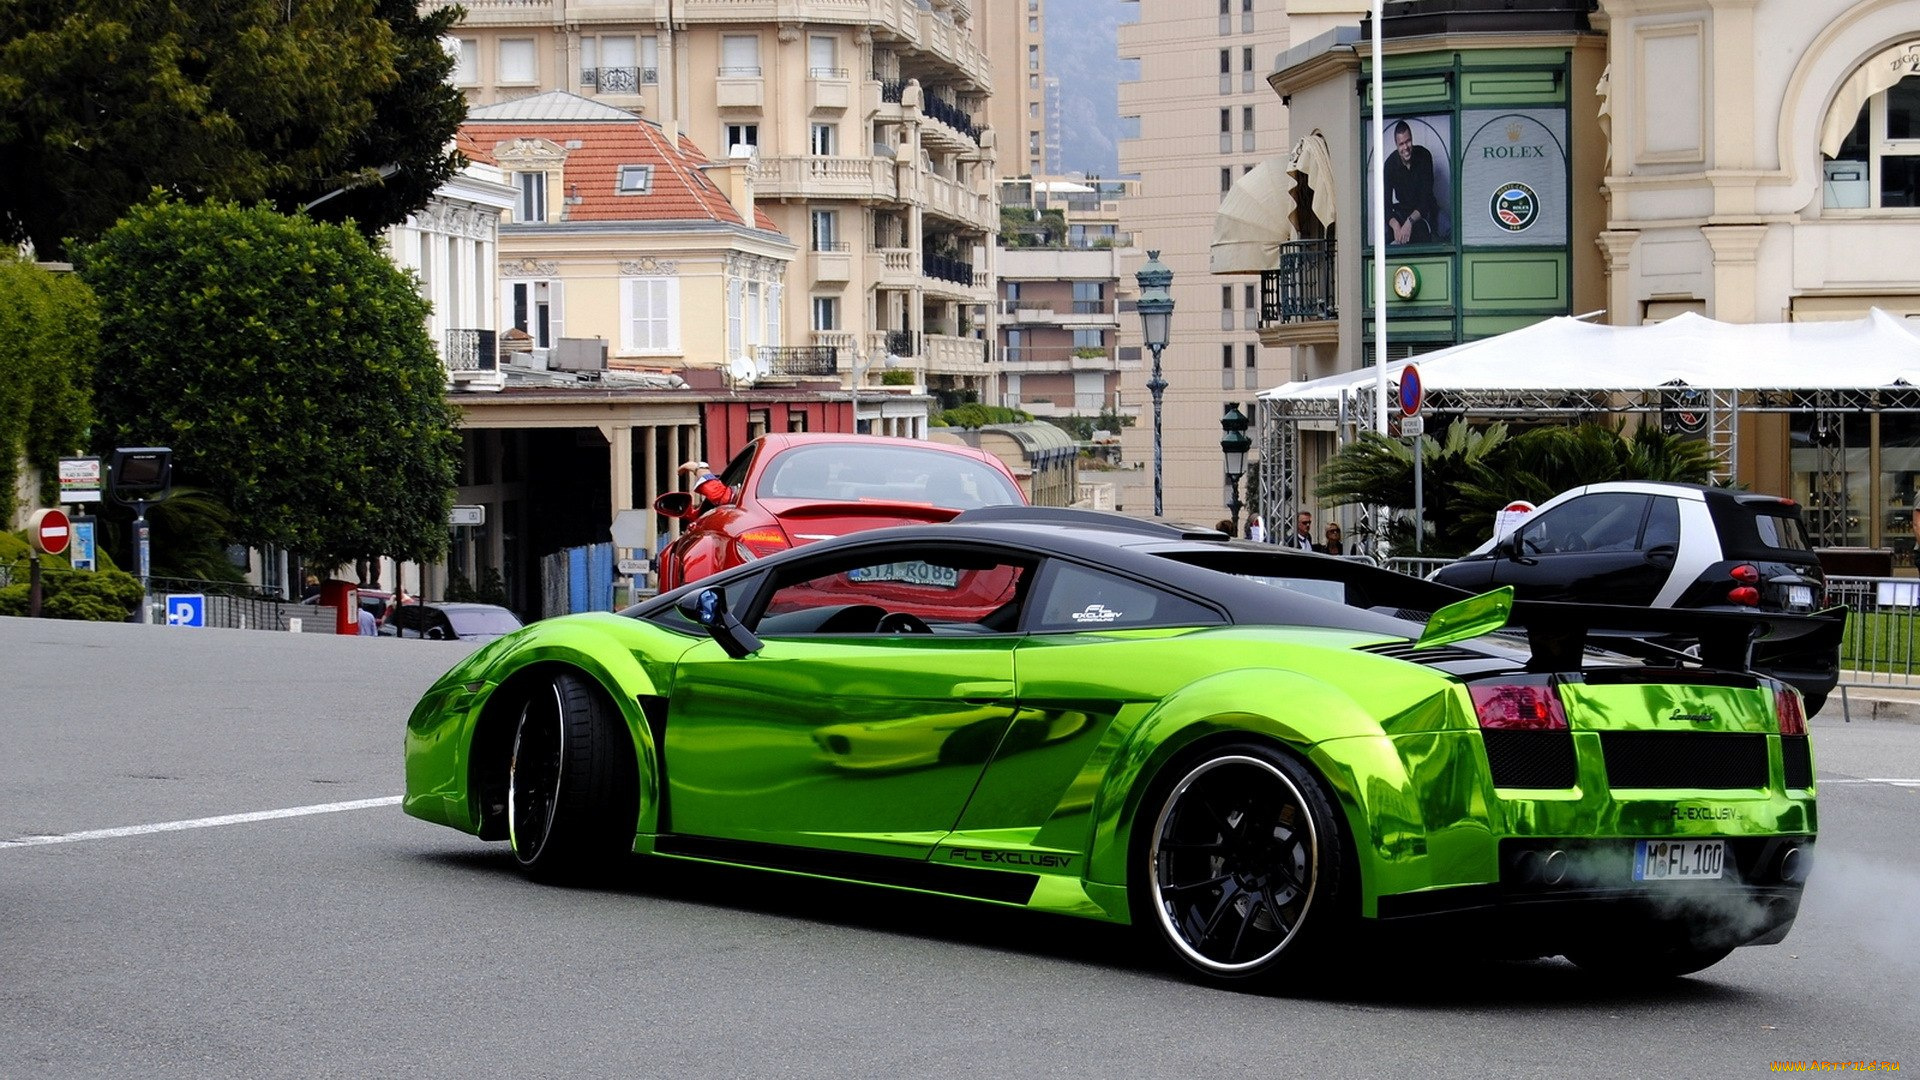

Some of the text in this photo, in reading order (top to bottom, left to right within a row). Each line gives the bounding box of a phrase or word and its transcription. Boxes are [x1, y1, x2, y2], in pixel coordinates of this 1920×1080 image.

[1483, 146, 1543, 158] ROLEX
[949, 848, 1071, 867] FL EXCLUSIV
[1691, 844, 1722, 874] 100
